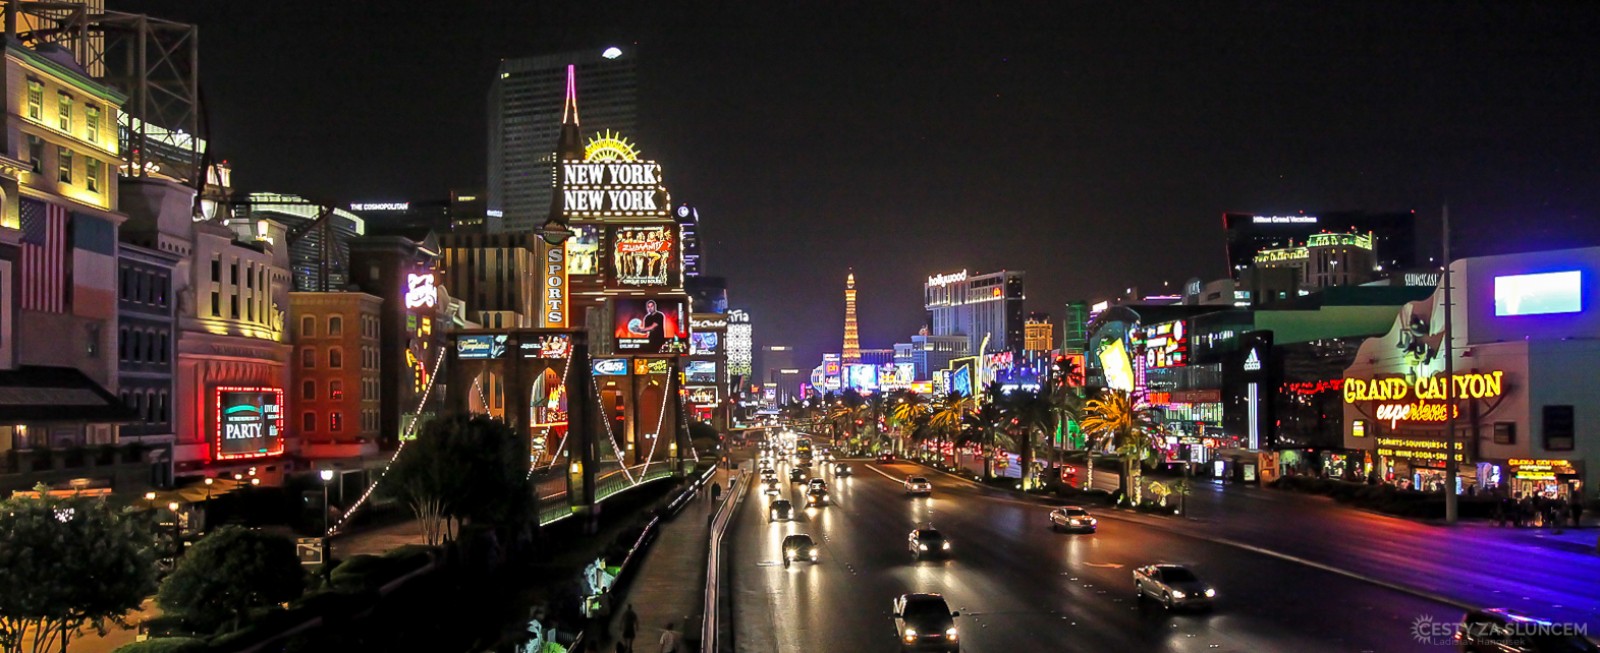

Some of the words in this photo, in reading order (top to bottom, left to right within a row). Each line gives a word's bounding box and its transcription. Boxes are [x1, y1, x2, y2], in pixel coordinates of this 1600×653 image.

[564, 164, 604, 185] NEW
[608, 164, 657, 185] YORK
[350, 203, 363, 211] THE
[364, 202, 409, 211] COSMOPOLITAN
[564, 190, 604, 211] NEW
[608, 190, 657, 211] YORK
[1253, 215, 1271, 223] Hilton
[1272, 215, 1289, 223] Grand
[1290, 215, 1317, 223] Vacations
[622, 241, 664, 252] ZUMANITY
[548, 249, 563, 323] SPORTS
[929, 269, 967, 287] hollywood
[1344, 377, 1407, 403] GRAND
[1414, 370, 1504, 399] CANYON
[226, 423, 262, 439] PARTY
[1377, 448, 1392, 456] BEER
[1395, 449, 1412, 458] WINE
[1415, 451, 1432, 459] SODA
